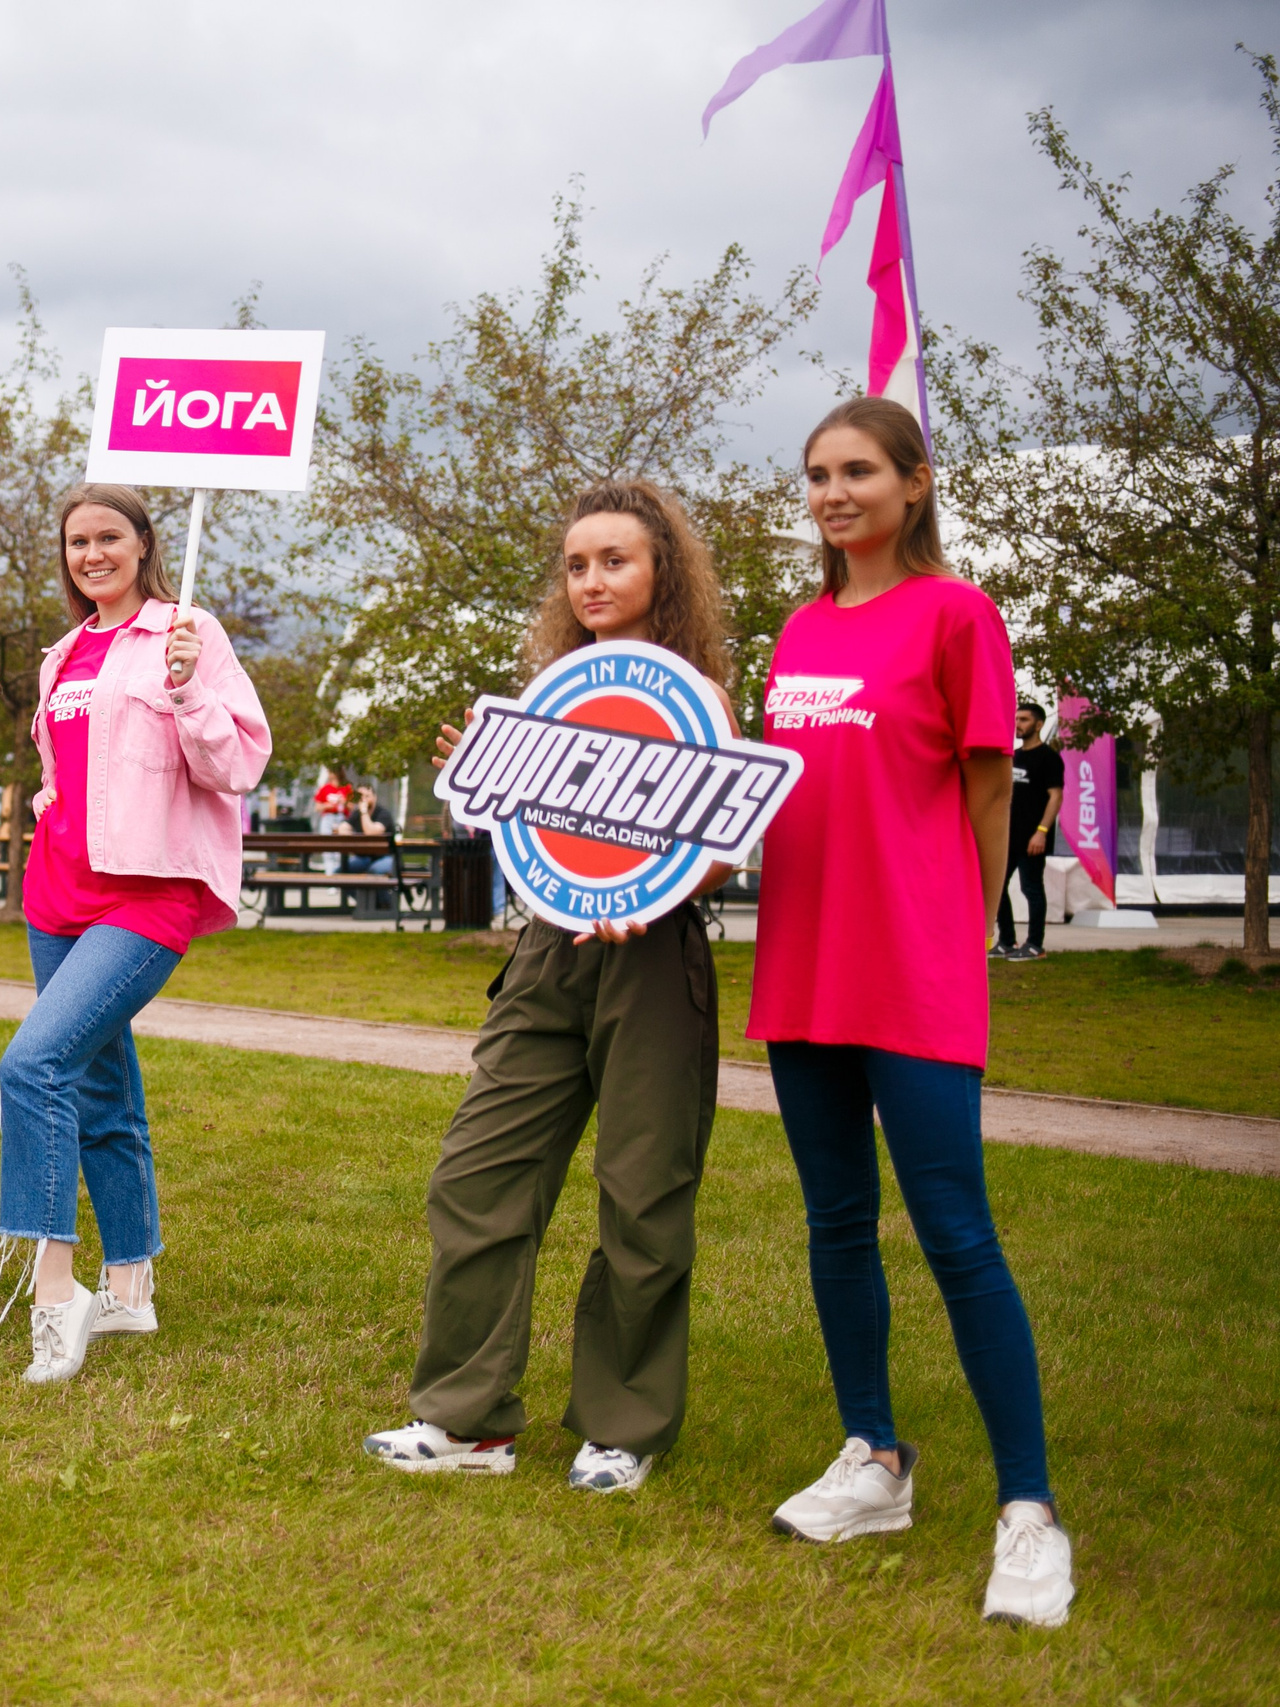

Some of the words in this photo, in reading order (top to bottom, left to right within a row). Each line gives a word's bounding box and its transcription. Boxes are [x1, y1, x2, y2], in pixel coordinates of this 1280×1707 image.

[132, 378, 288, 431] ЙОГА
[590, 660, 615, 685] IN
[625, 660, 672, 696] MIX
[50, 687, 94, 707] СТРАН
[767, 688, 845, 708] СТРАНА
[54, 708, 77, 723] БЕЗ
[773, 713, 806, 729] БЕЗ
[810, 708, 877, 730] ГРАНИЦ
[453, 713, 783, 844] UPPERCUTS
[523, 807, 578, 831] MUSIC
[580, 820, 673, 852] ACADEMY
[526, 858, 562, 902] WE
[568, 884, 639, 915] TRUST
